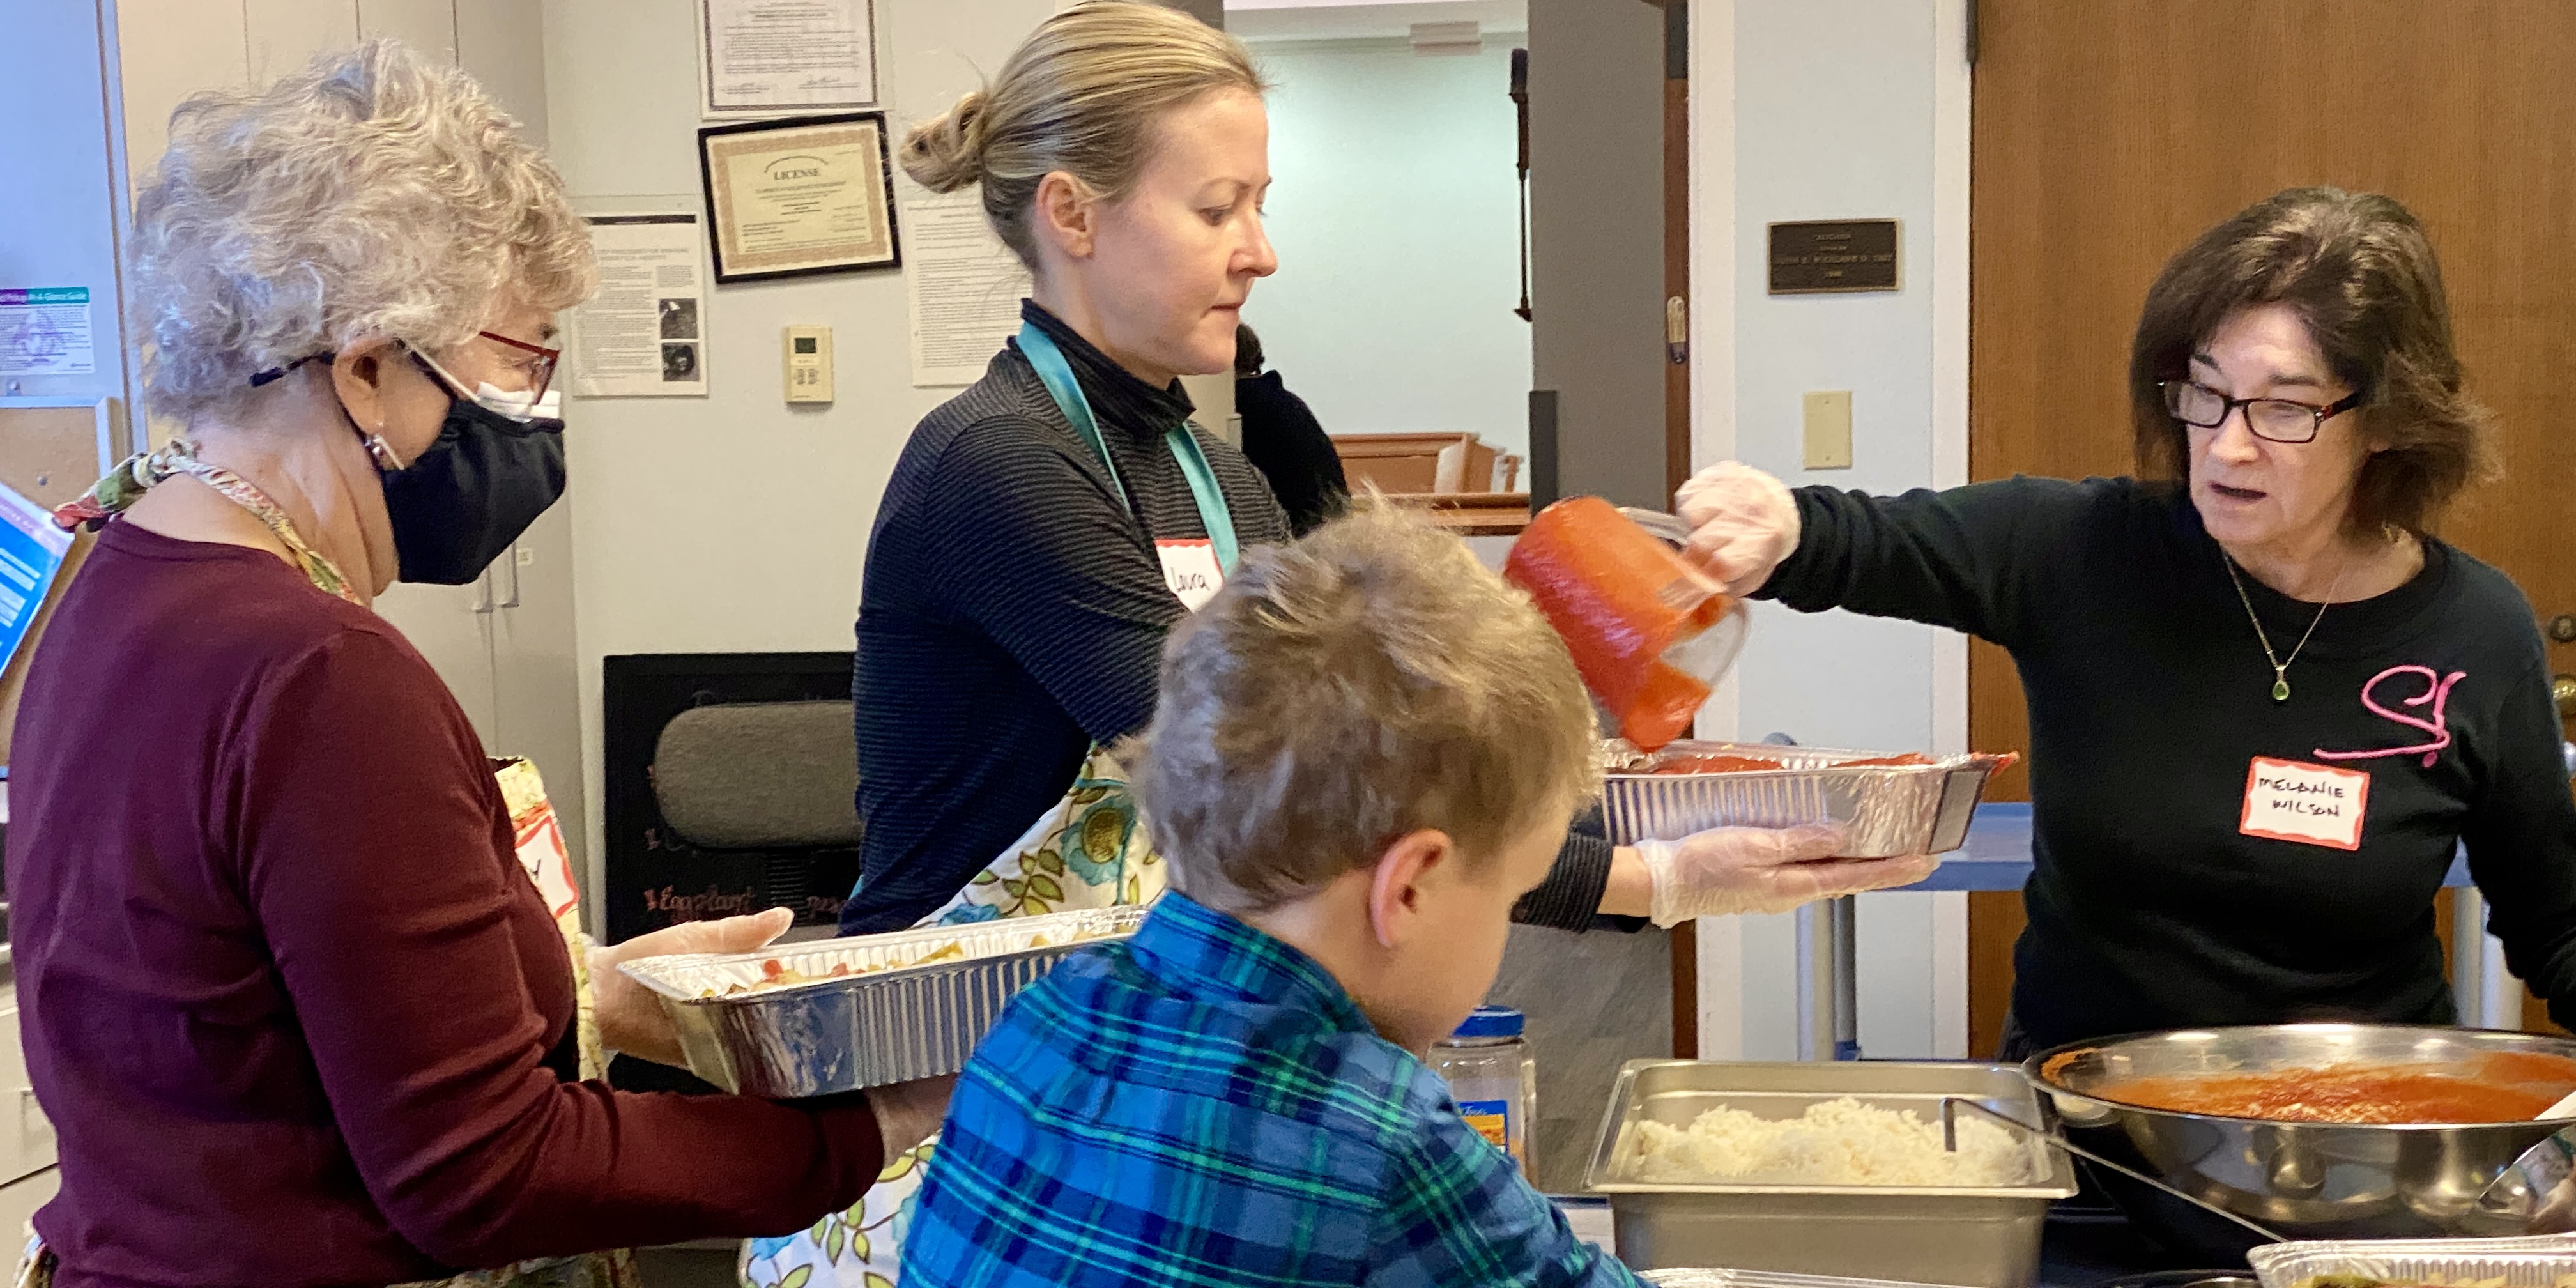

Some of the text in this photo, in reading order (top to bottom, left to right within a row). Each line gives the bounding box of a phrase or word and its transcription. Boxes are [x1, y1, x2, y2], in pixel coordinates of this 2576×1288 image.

[773, 168, 821, 180] LICENSE
[2258, 778, 2344, 798] MELANIE
[2272, 799, 2340, 817] WILSON
